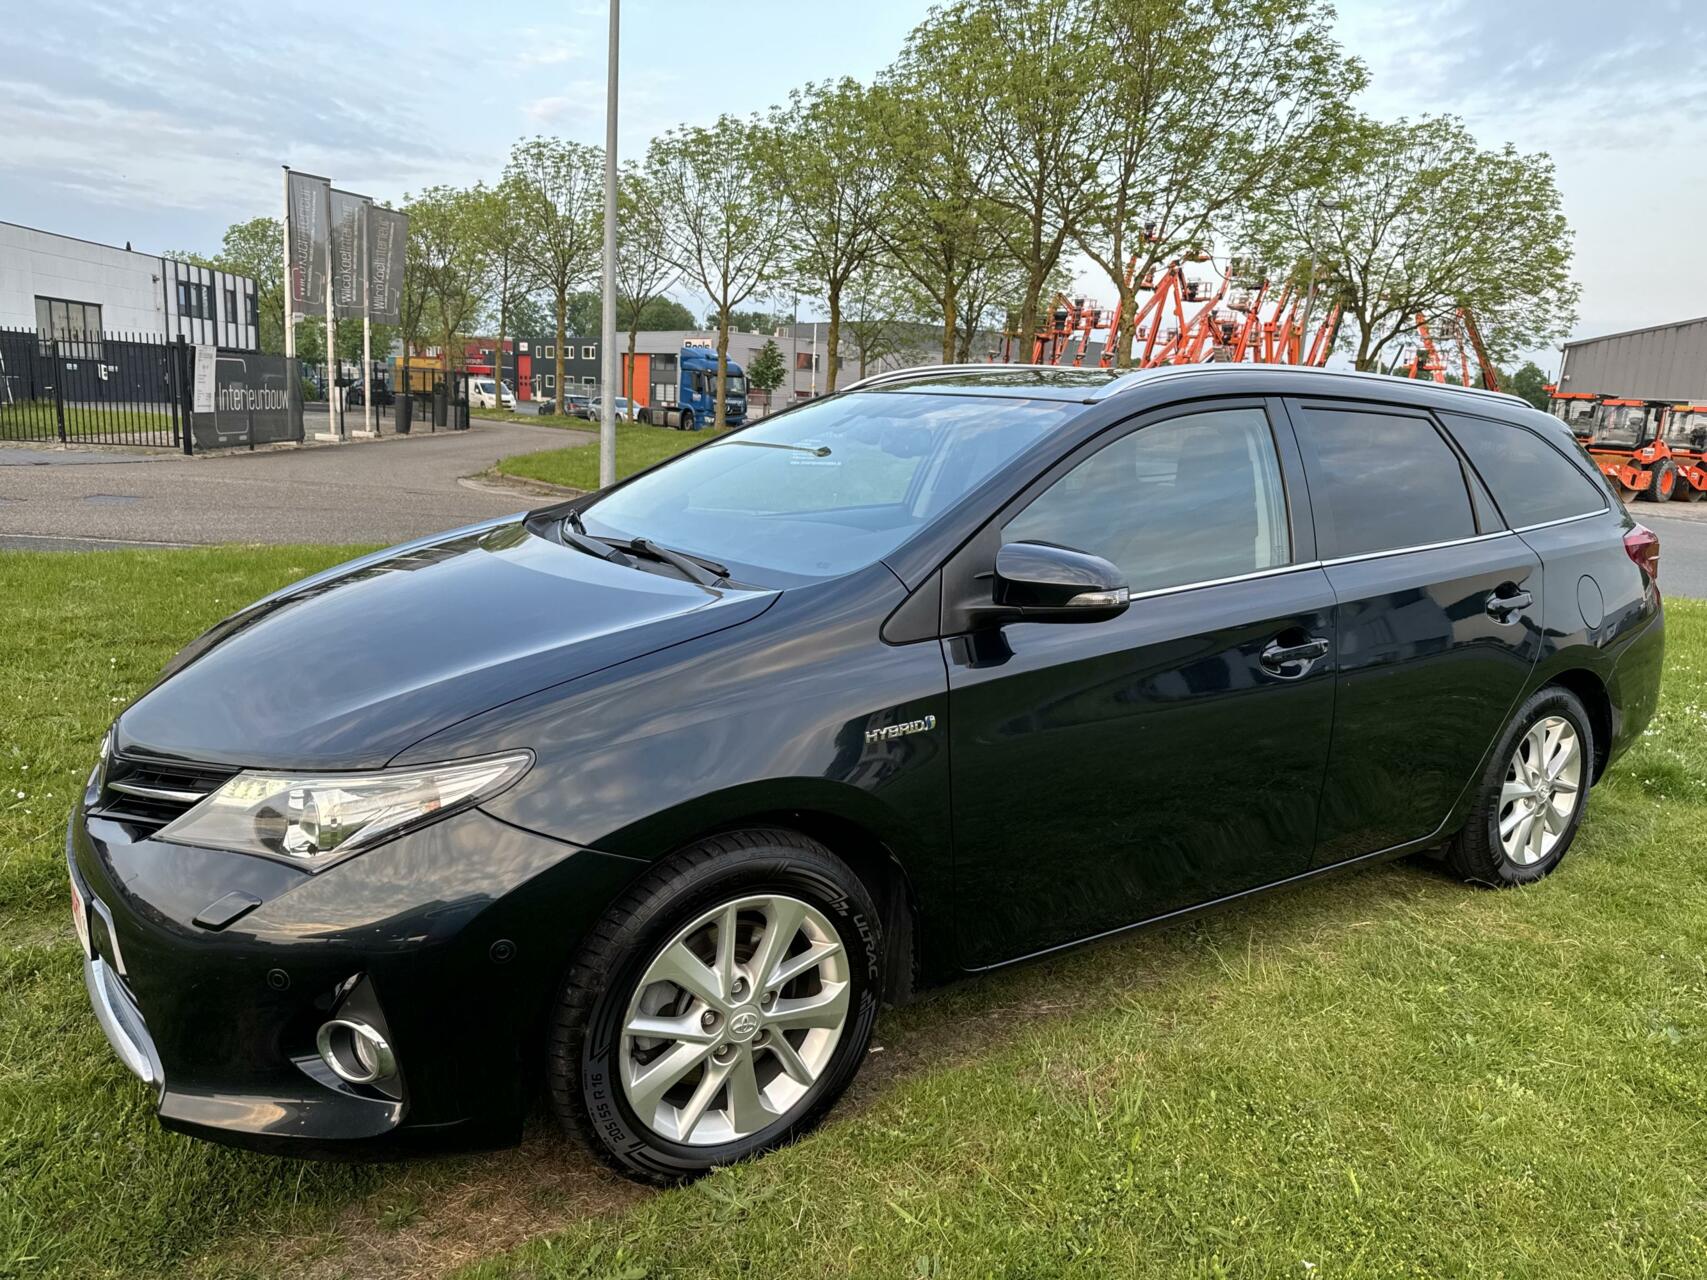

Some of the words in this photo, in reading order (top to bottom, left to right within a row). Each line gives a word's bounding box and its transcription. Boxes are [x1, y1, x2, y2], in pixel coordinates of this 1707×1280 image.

[218, 382, 288, 411] Interieurbouw
[865, 719, 925, 744] HYBRID
[853, 913, 878, 980] ULTRAC
[596, 1103, 627, 1143] 205/55
